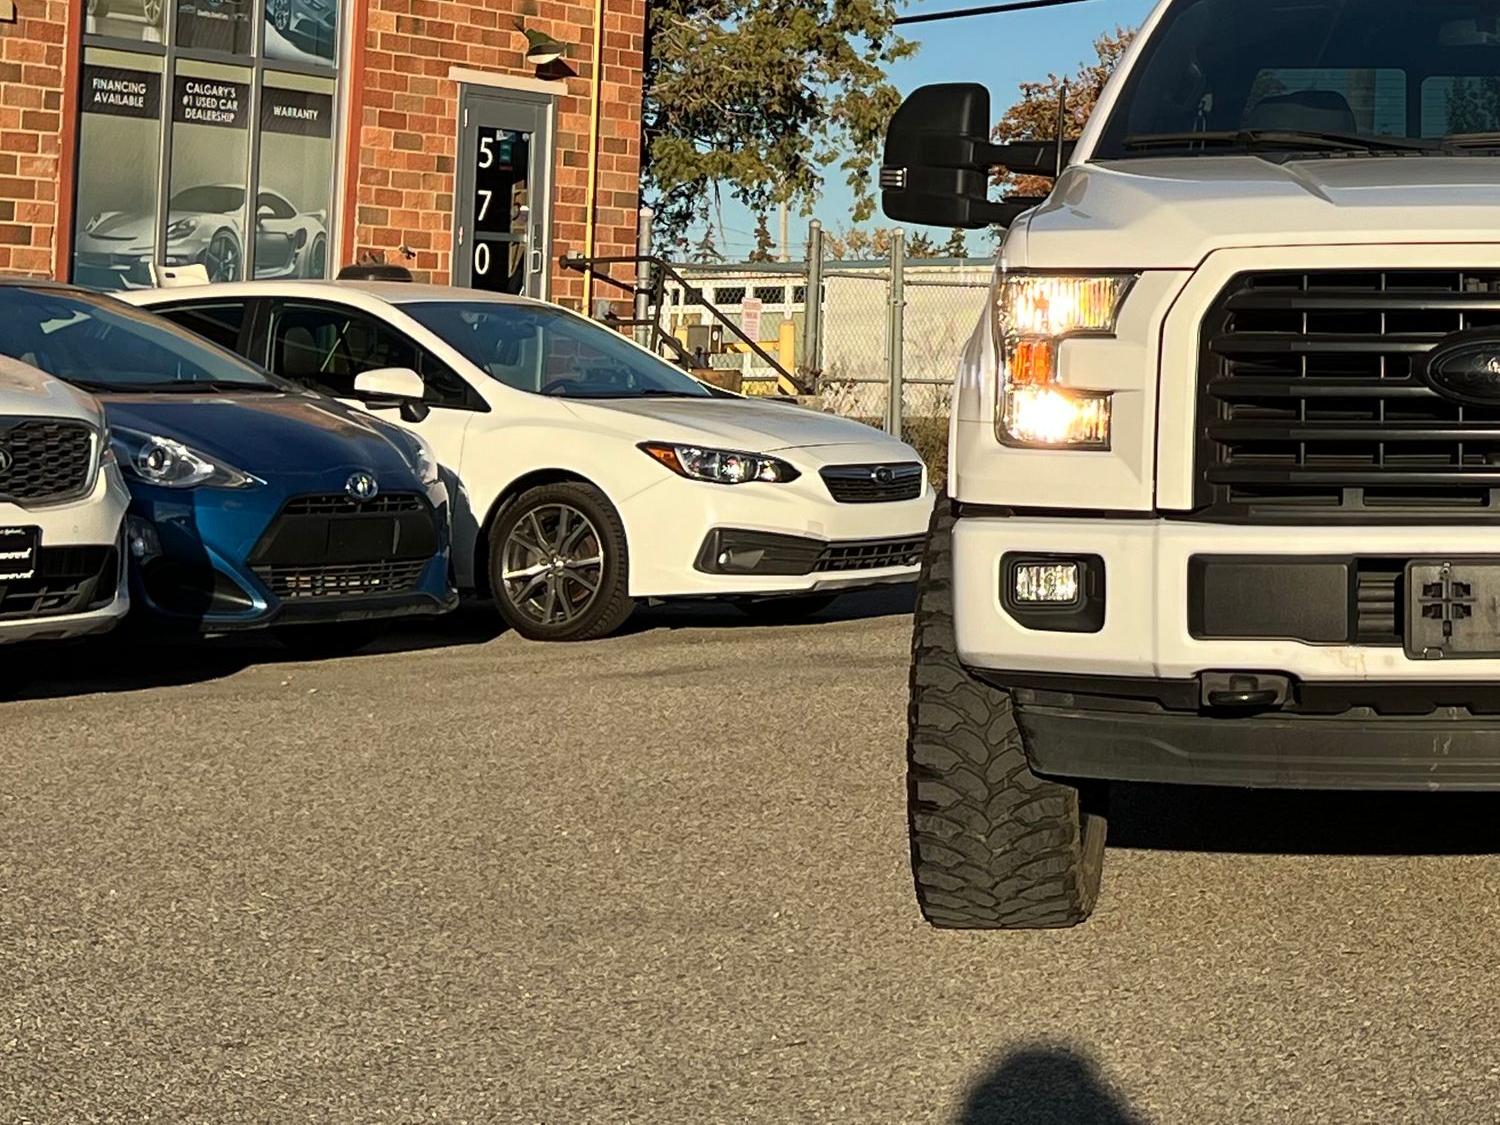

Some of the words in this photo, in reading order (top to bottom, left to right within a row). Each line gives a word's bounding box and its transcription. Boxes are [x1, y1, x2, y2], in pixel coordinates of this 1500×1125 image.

[92, 78, 147, 95] FINANCING
[185, 82, 236, 99] CALGARY'S
[94, 92, 144, 107] AVAILABLE
[182, 95, 193, 106] #1
[195, 97, 218, 107] USED
[218, 100, 239, 112] CAR
[185, 108, 235, 123] DEALERSHIP
[273, 105, 319, 121] WARRANTY
